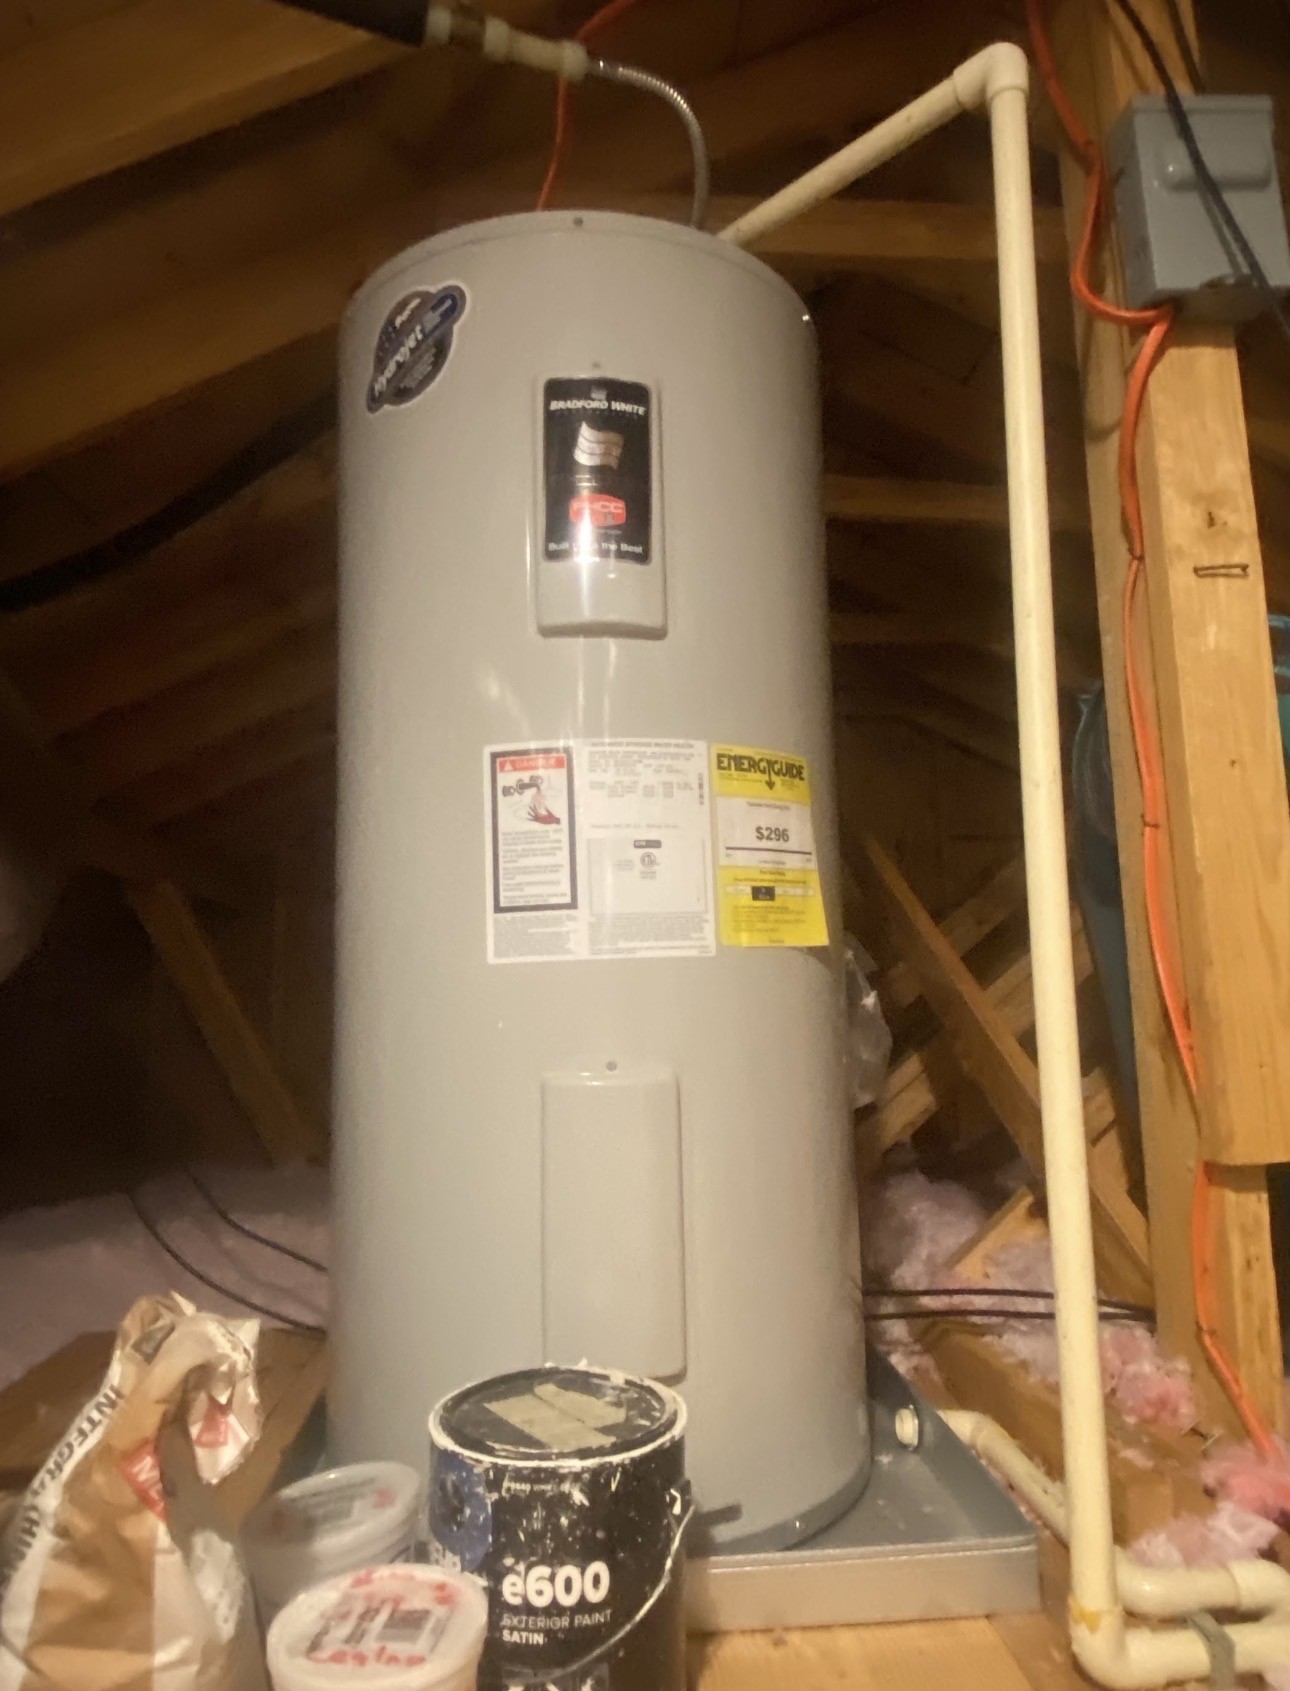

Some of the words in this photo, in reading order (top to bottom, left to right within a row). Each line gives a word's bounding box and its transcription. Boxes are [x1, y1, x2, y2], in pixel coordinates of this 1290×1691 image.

[549, 400, 609, 412] BRADFORD
[611, 401, 647, 416] WHITE
[755, 826, 790, 843] $296
[502, 1560, 611, 1608] e600
[501, 1612, 570, 1632] EXTERIOR
[574, 1609, 612, 1627] PAINT
[502, 1629, 545, 1646] SATIN
